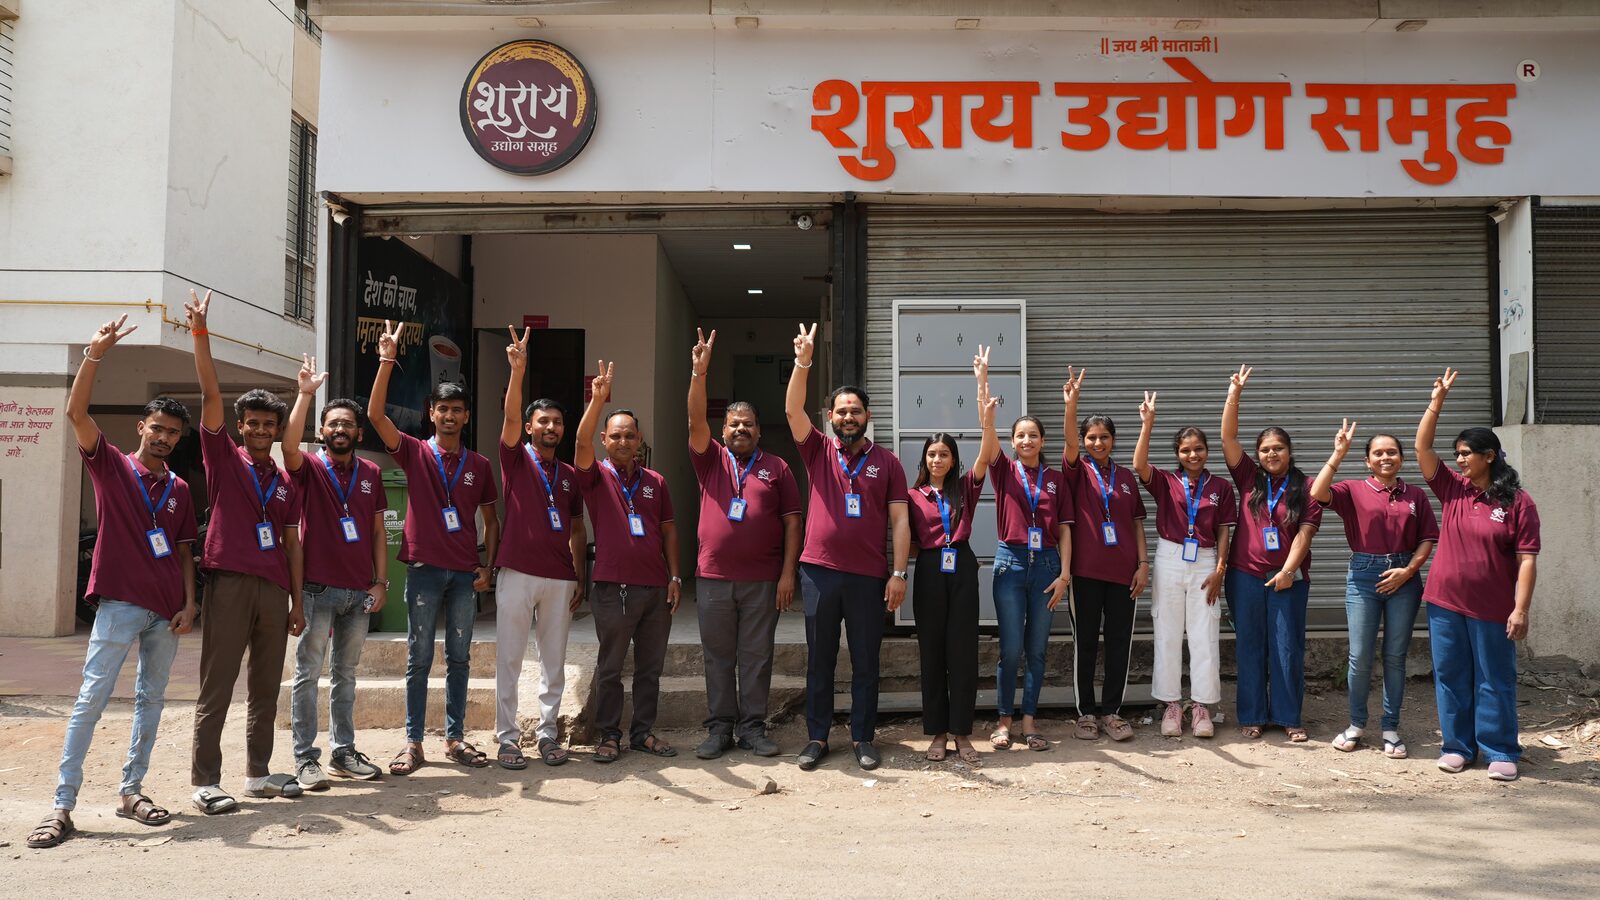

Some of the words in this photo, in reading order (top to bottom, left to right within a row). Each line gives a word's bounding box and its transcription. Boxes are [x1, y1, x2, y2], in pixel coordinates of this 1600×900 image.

[1112, 40, 1137, 52] जय
[1140, 36, 1159, 52] श्री
[1161, 36, 1211, 52] माताजी
[811, 79, 1040, 181] शुराय
[1055, 57, 1291, 151] उद्योग
[1305, 83, 1517, 186] समुह
[491, 136, 523, 152] उद्योग
[527, 142, 557, 156] समुह
[364, 270, 382, 308] देश
[383, 275, 398, 308] की
